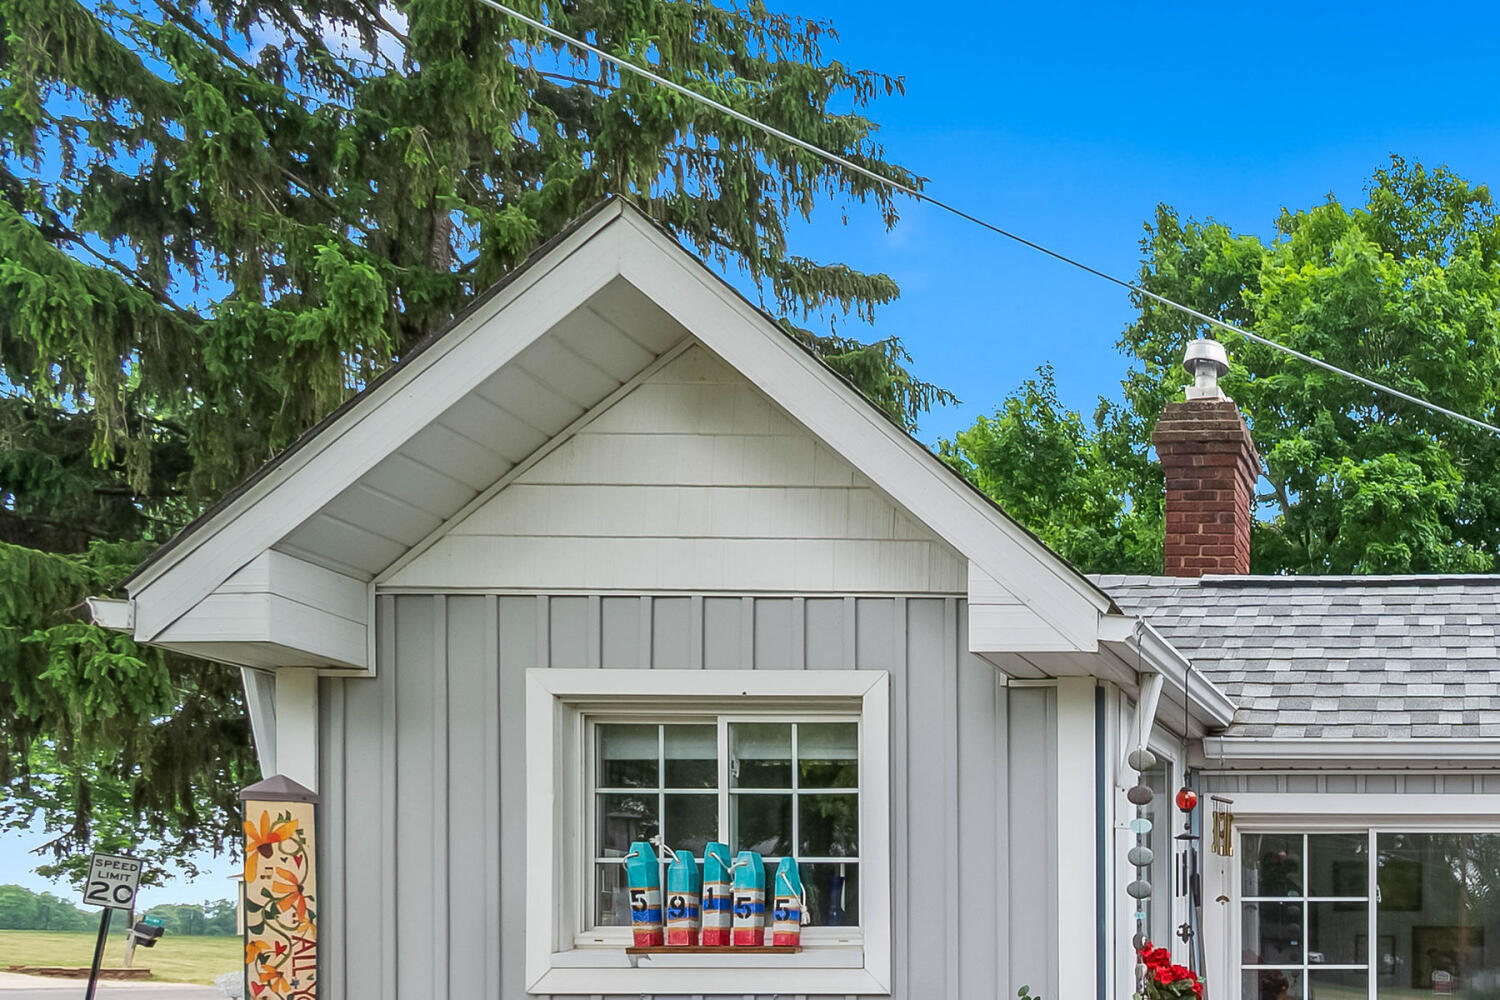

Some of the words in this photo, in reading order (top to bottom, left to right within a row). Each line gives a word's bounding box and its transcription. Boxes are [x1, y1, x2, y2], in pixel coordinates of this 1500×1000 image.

[95, 859, 138, 872] SPEED
[98, 871, 131, 881] LIMIT
[87, 881, 134, 904] 20
[630, 889, 648, 912] 5
[669, 895, 686, 918] 9
[706, 886, 714, 910] 1
[736, 896, 752, 919] 5
[774, 898, 790, 921] 5
[291, 935, 316, 977] ALL
